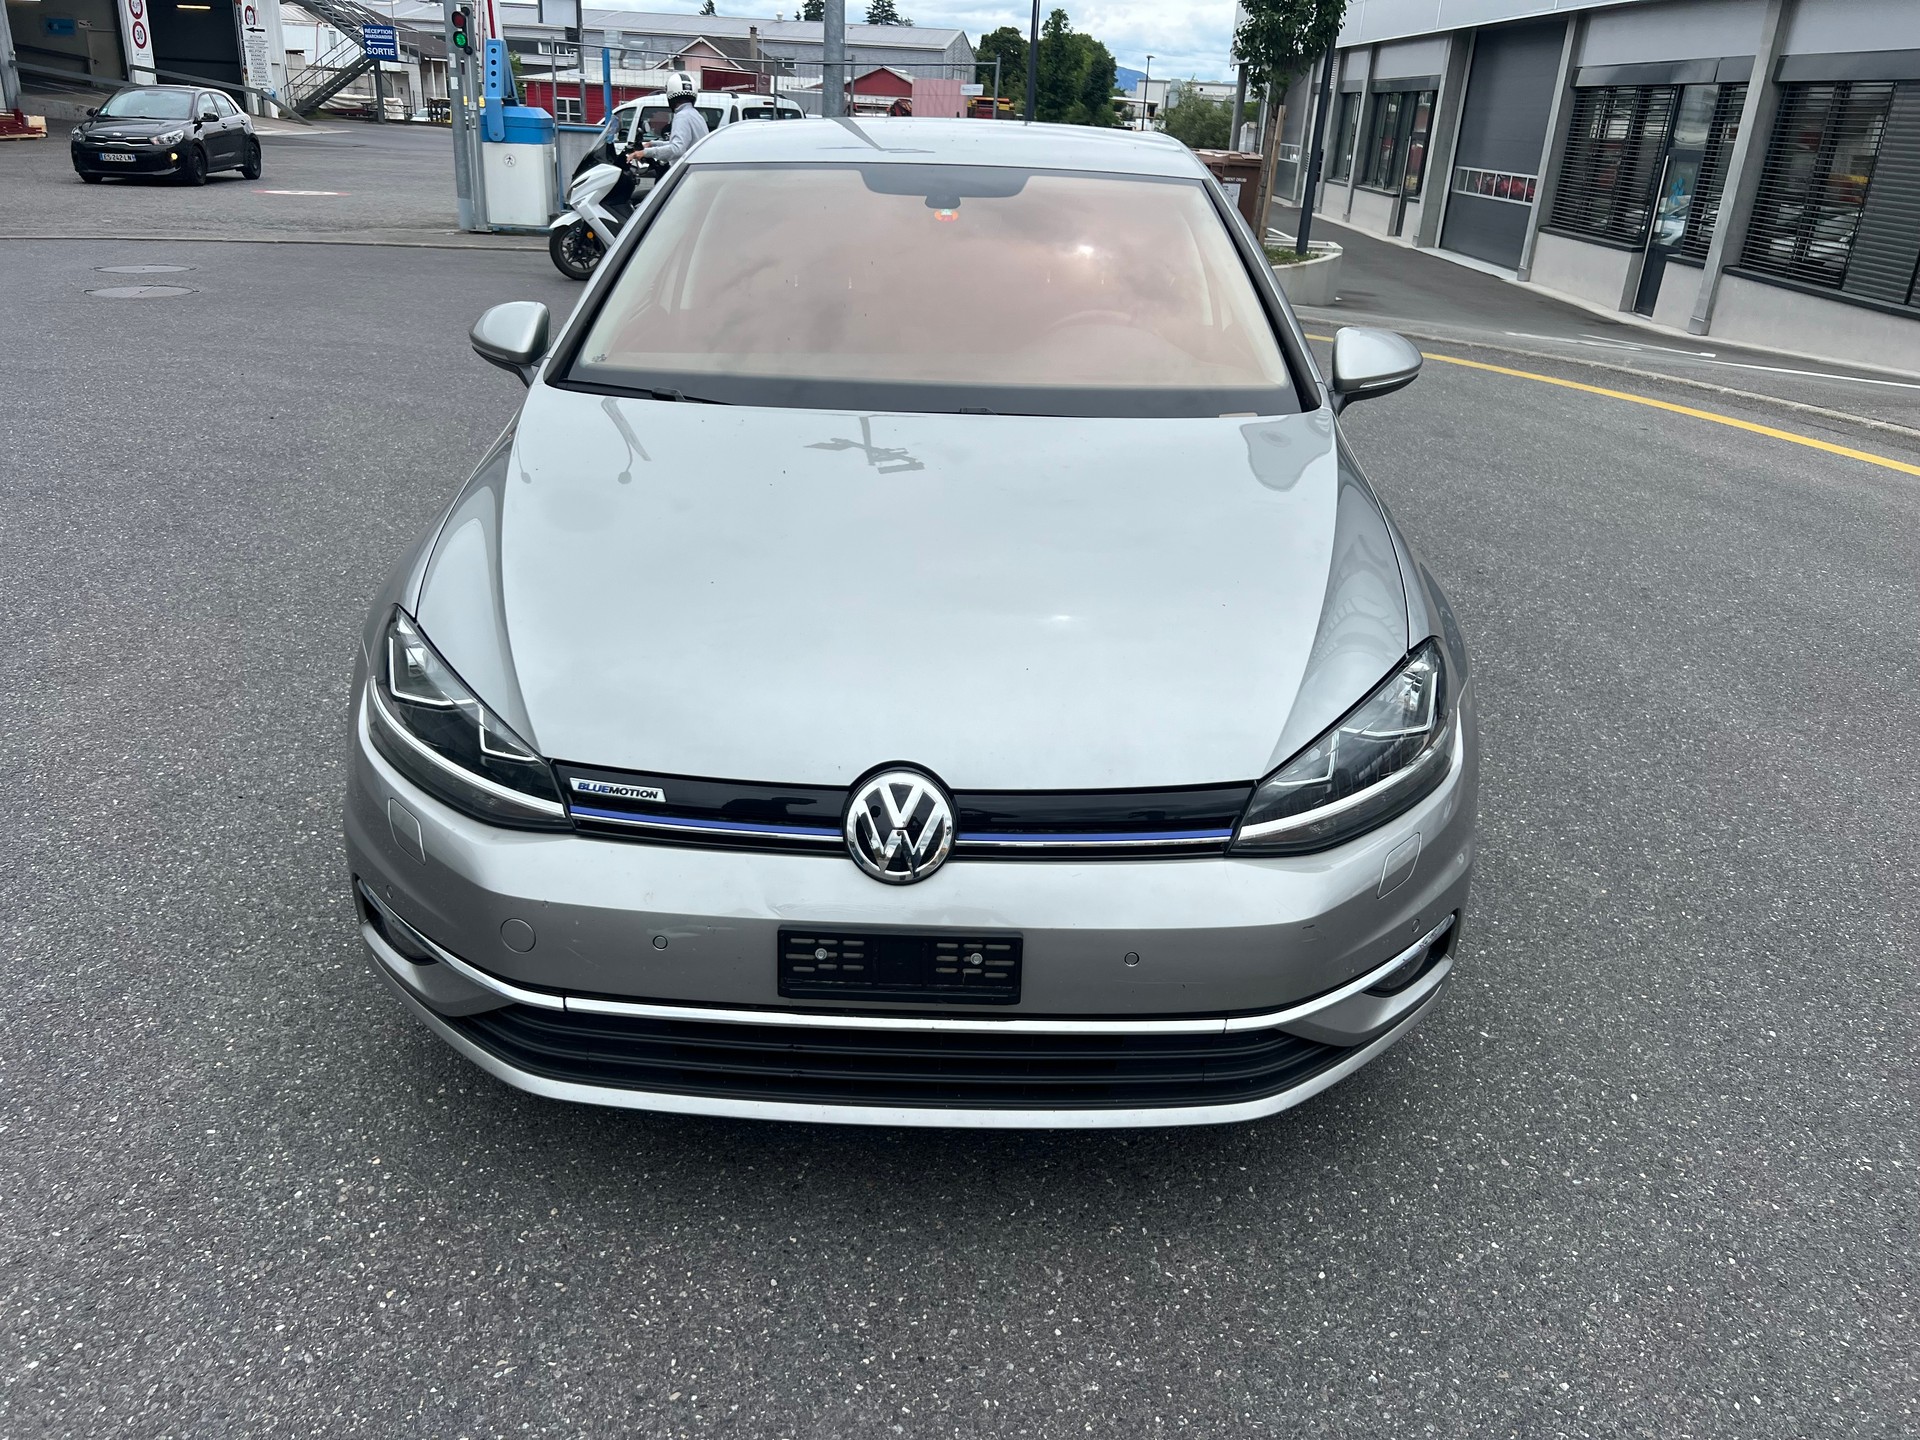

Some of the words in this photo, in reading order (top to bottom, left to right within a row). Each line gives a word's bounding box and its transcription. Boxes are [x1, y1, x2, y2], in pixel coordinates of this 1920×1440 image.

[136, 29, 144, 40] 30
[366, 47, 395, 56] SORTIE
[577, 782, 659, 799] BLUEMOTION
[850, 775, 949, 878] VW
